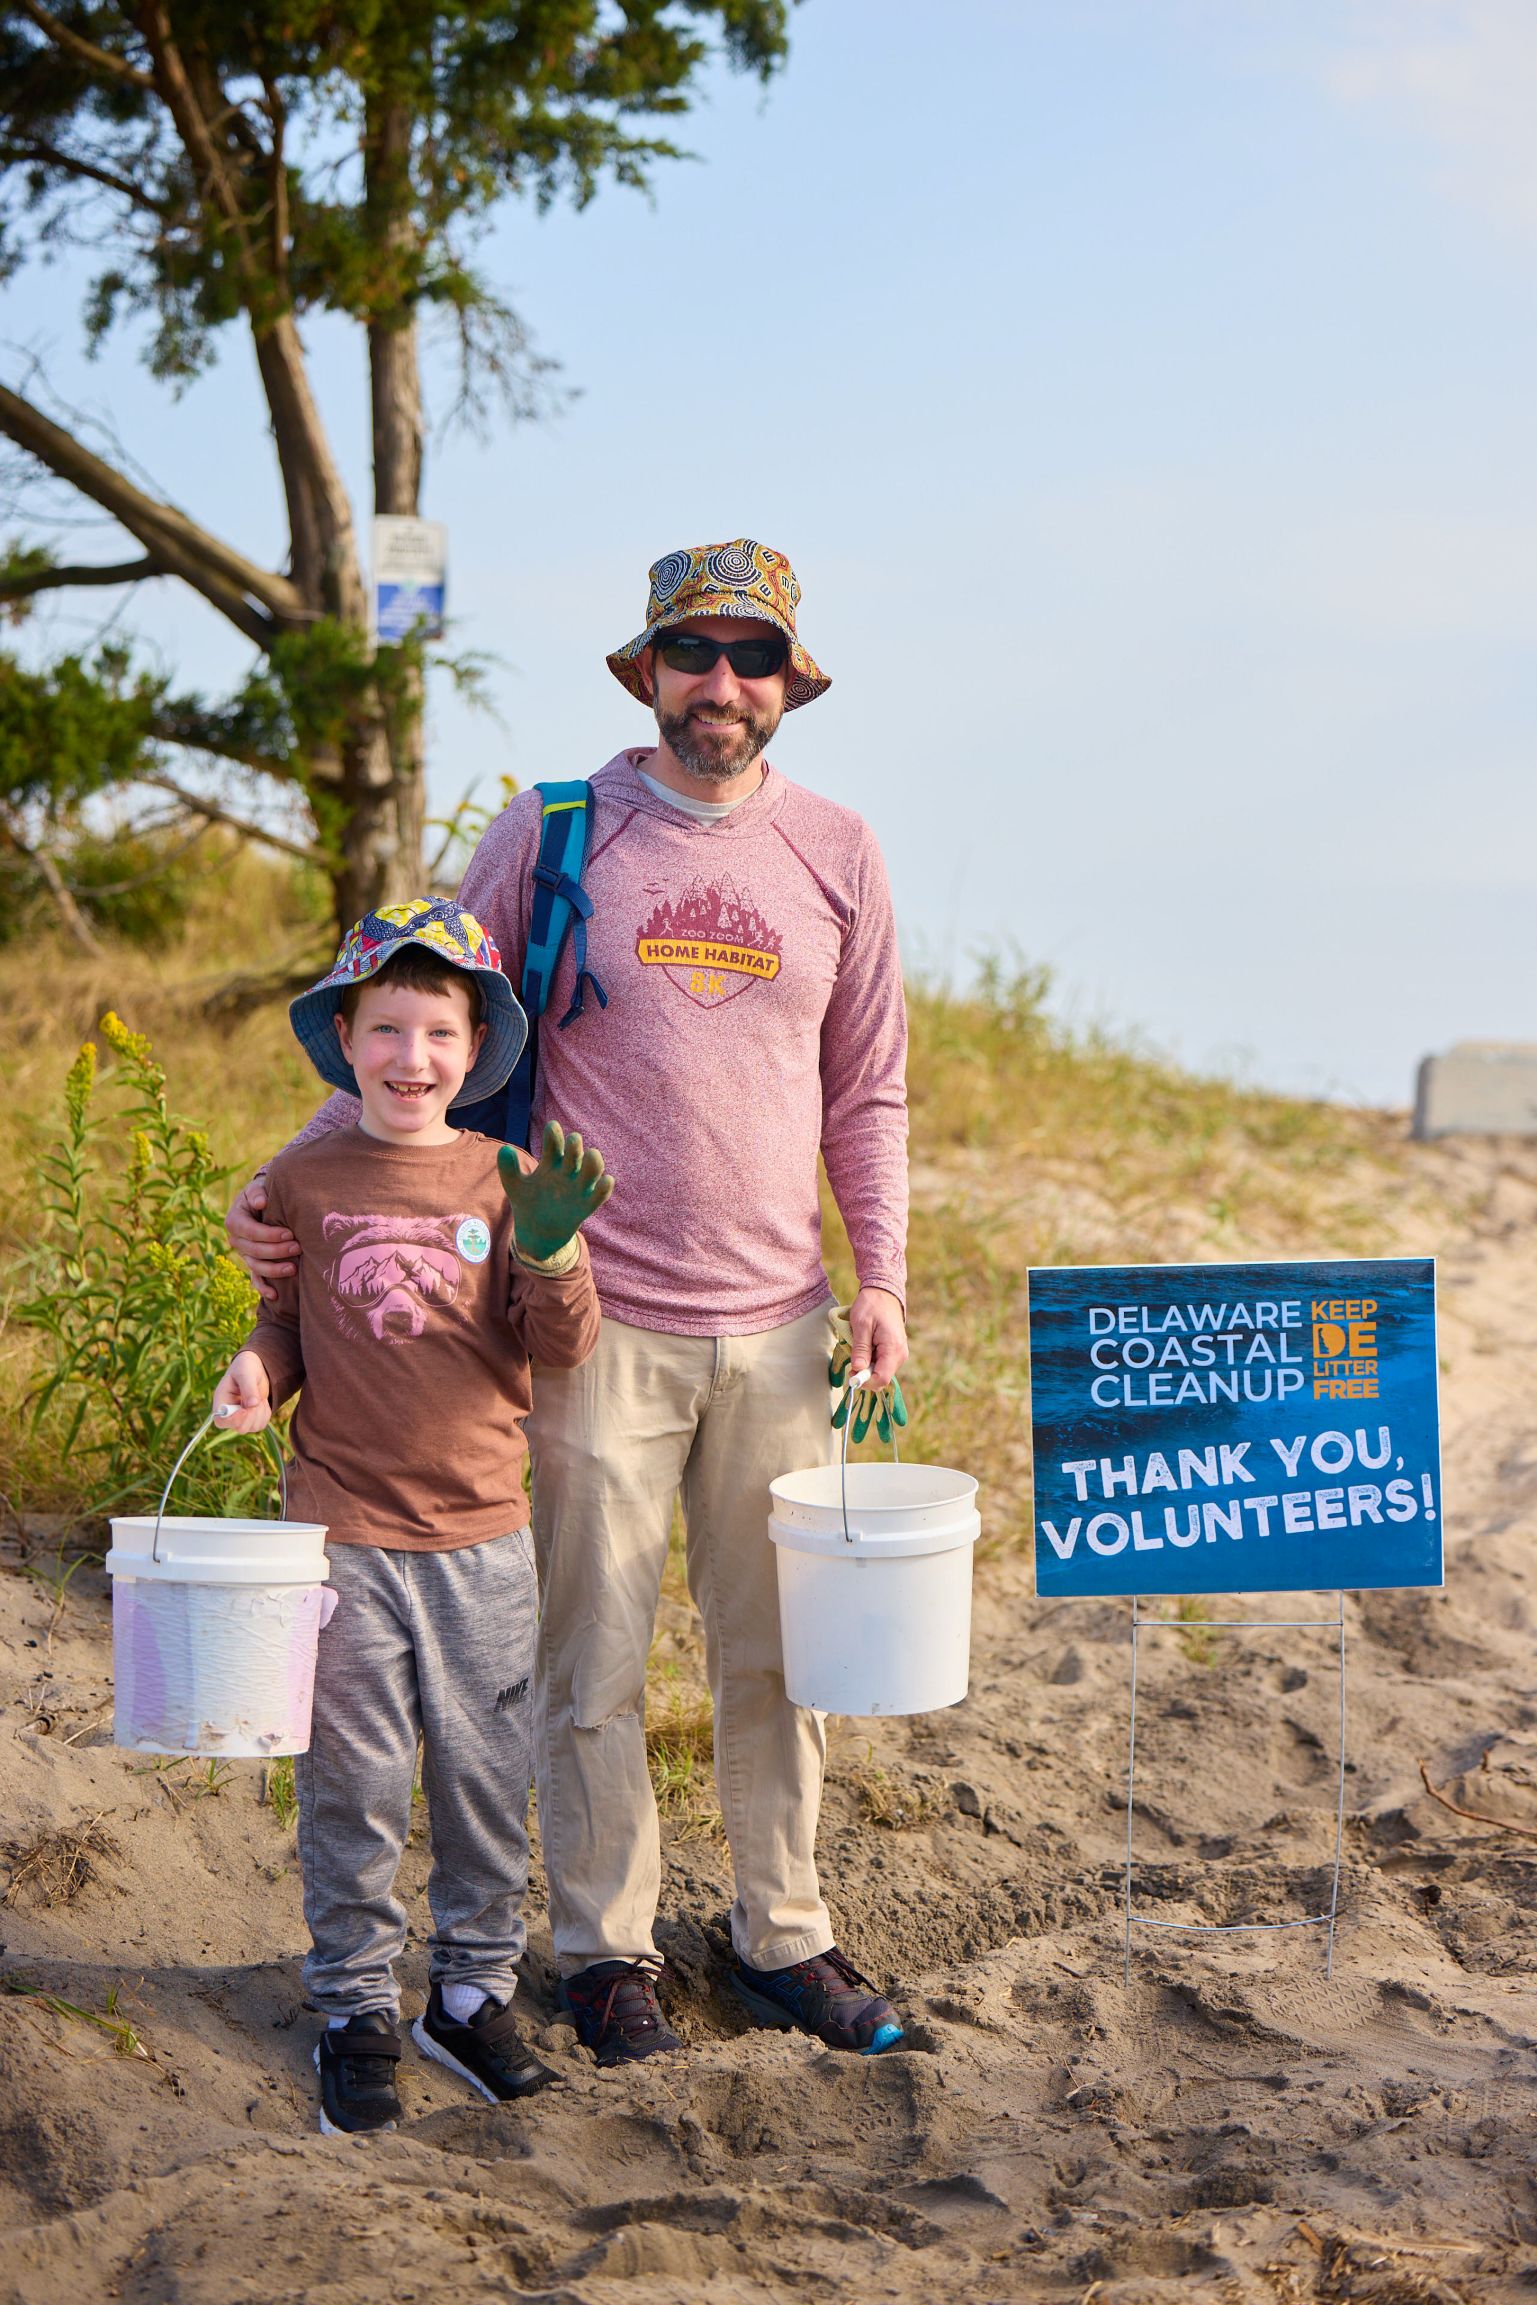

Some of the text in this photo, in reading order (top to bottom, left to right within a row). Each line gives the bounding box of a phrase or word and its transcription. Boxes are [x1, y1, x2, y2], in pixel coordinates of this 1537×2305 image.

[681, 929, 744, 944] ZOO ZOOM
[646, 944, 775, 972] HOME HABITAT
[689, 971, 727, 997] 8K
[1088, 1300, 1303, 1335] DELAWARE
[1311, 1299, 1378, 1321] KEEP
[1090, 1332, 1303, 1370] COASTAL
[1312, 1321, 1379, 1358] DE
[1313, 1359, 1378, 1377] LITTER
[1090, 1368, 1305, 1408] CLEANUP
[1313, 1378, 1380, 1400] FREE
[1061, 1425, 1405, 1502] THANK YOU,
[1040, 1473, 1437, 1560] VOLUNTEERS!
